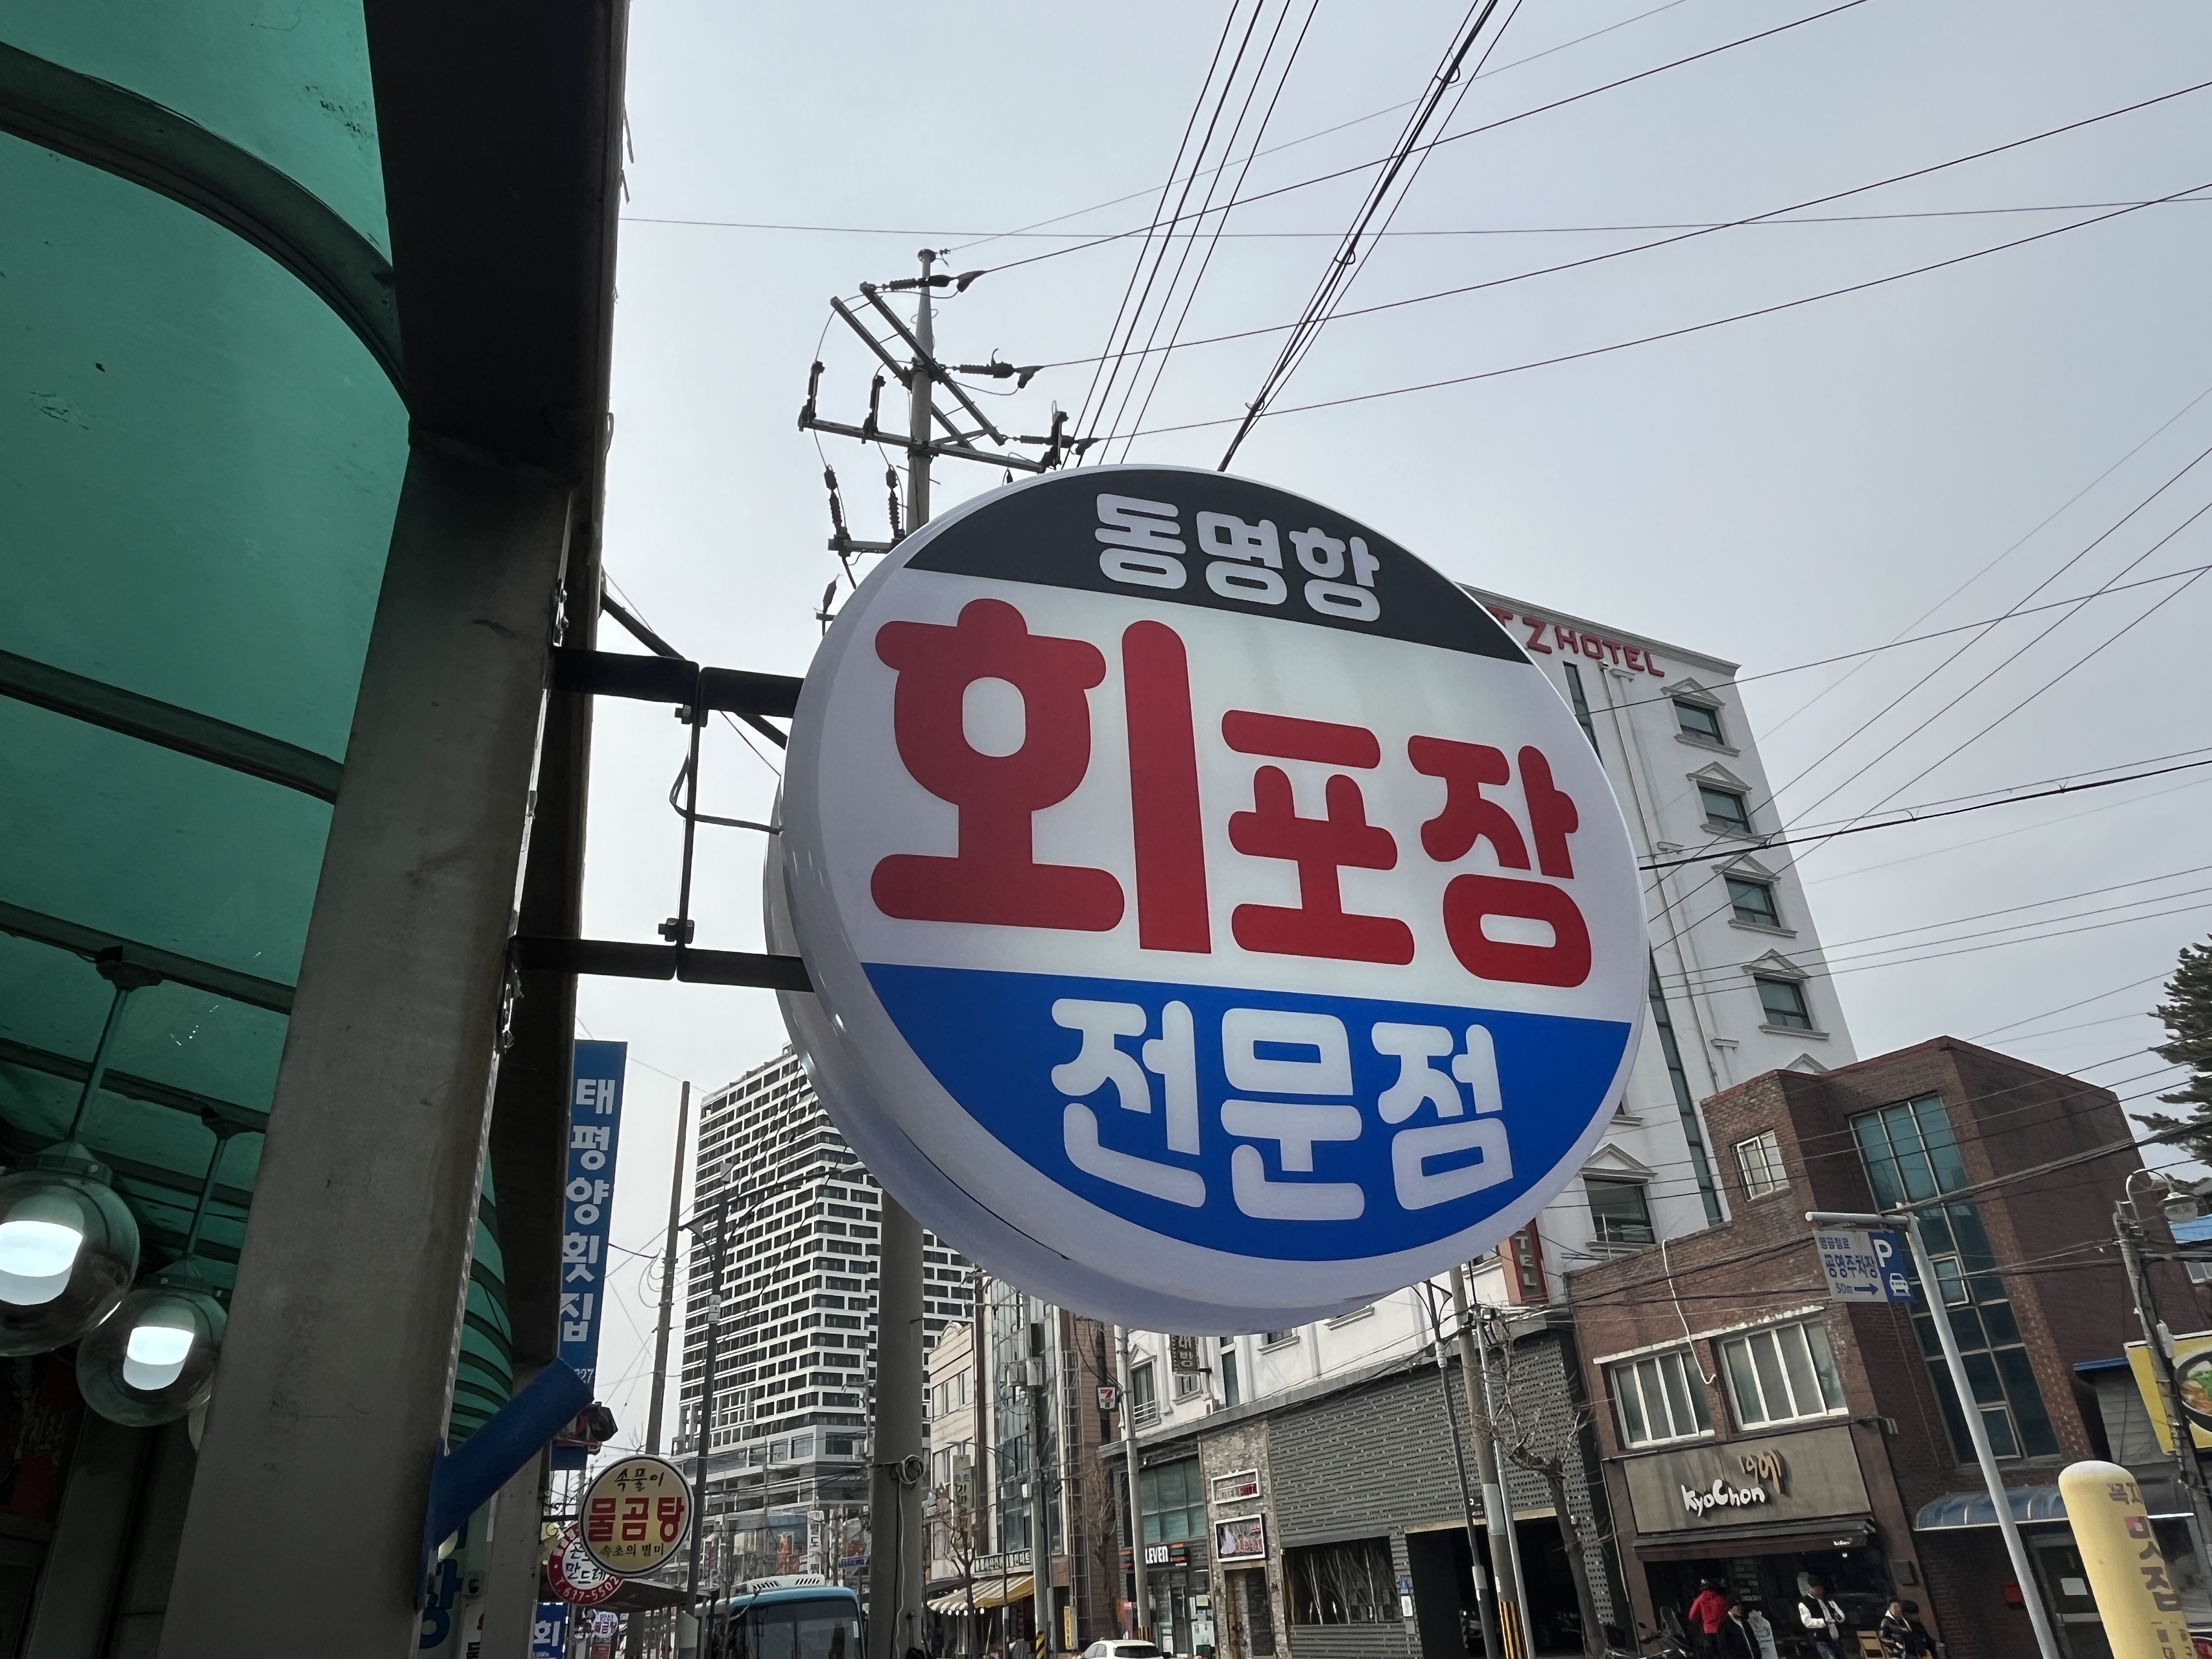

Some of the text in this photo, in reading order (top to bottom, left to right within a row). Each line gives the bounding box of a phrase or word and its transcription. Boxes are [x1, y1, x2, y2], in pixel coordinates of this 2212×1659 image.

[1094, 493, 1381, 622] 동명항
[1554, 625, 1665, 678] HOTEL
[1051, 998, 1514, 1221] 전문점
[560, 1079, 616, 1342] 태평양횟집
[1824, 1254, 1877, 1278] 공영주차장
[588, 1497, 685, 1543] 물곰탕
[1681, 1479, 1765, 1517] KyoChon
[533, 1620, 561, 1647] 회
